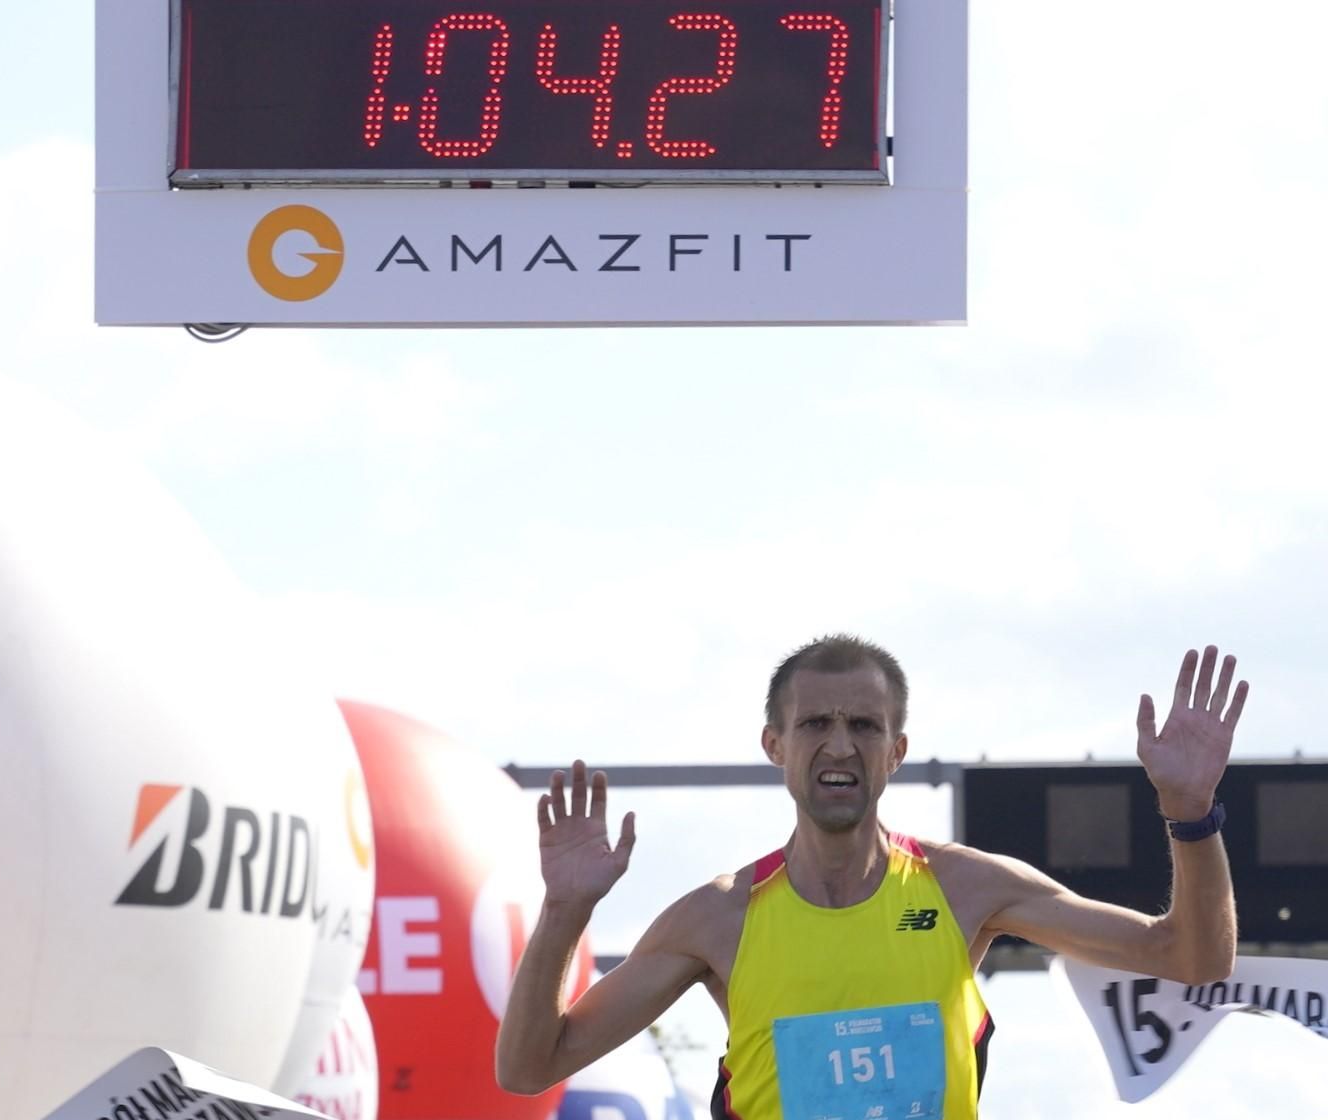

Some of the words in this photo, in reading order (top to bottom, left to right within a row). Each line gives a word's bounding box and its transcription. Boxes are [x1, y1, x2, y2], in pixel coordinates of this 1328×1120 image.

[375, 234, 812, 272] AMAZFIT
[111, 786, 322, 922] BRID
[828, 1044, 896, 1086] 151
